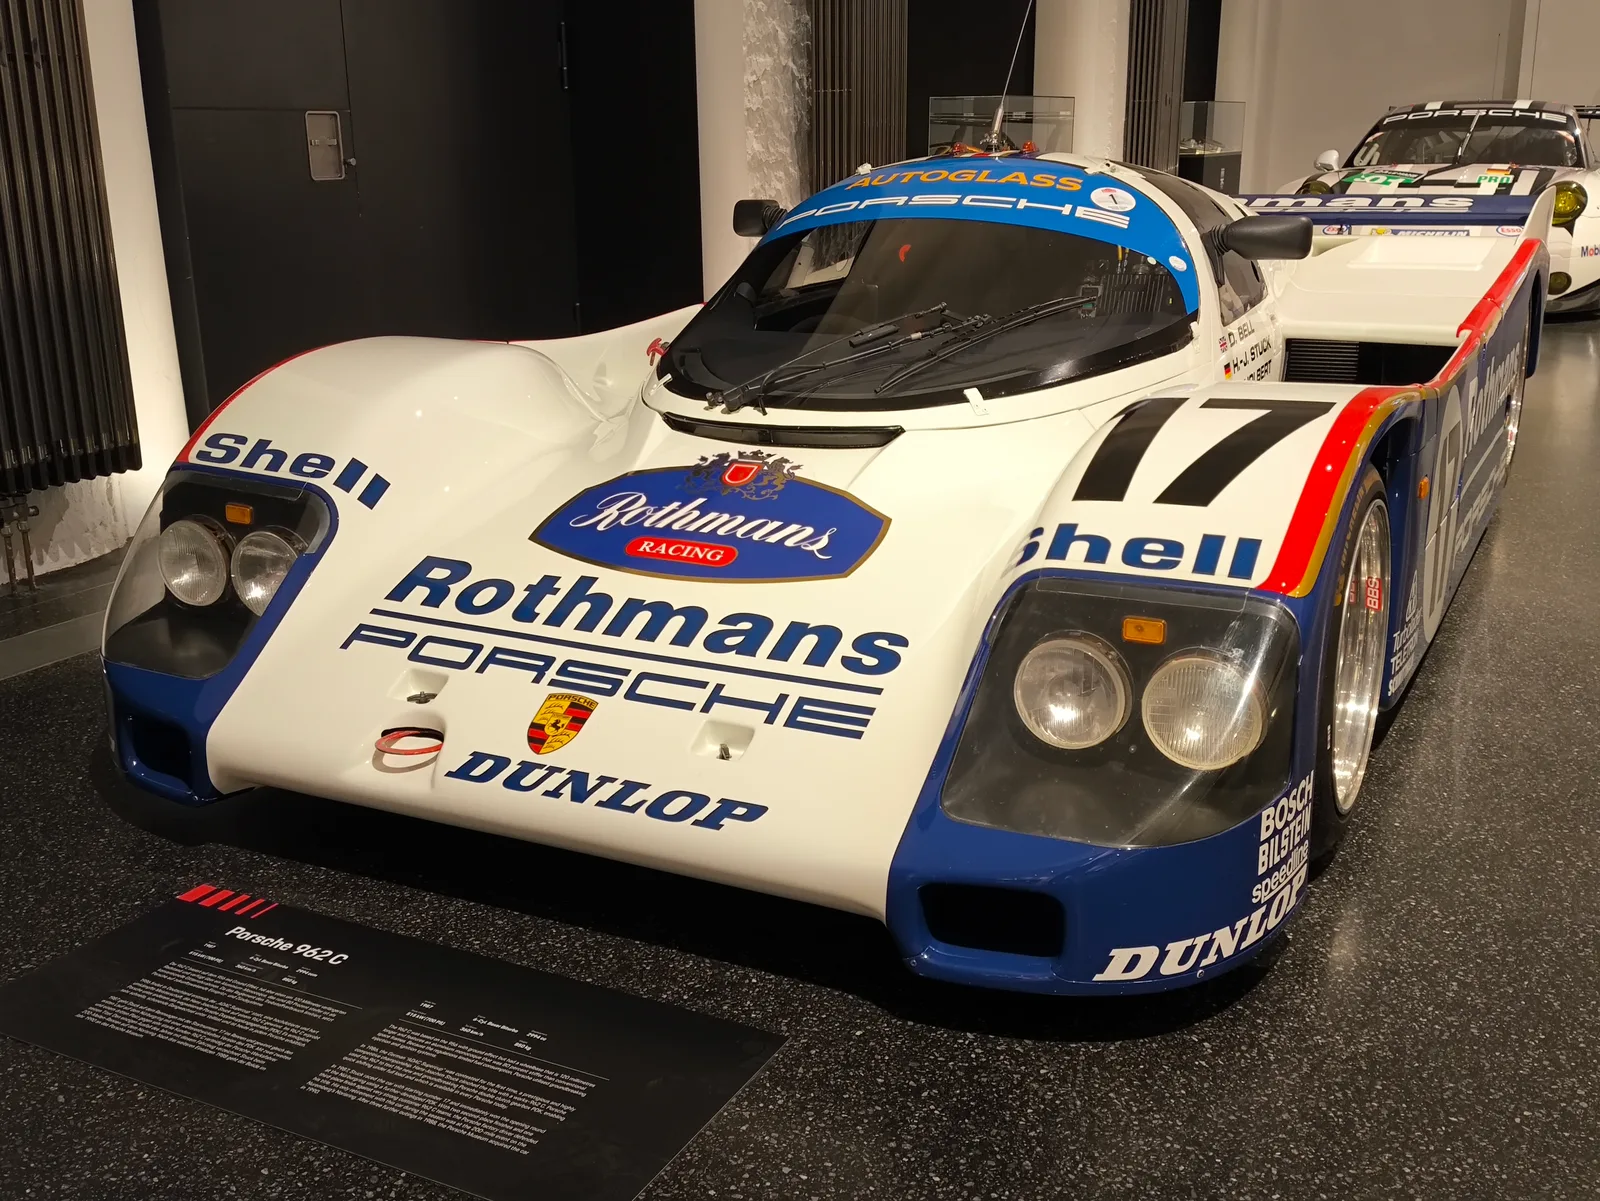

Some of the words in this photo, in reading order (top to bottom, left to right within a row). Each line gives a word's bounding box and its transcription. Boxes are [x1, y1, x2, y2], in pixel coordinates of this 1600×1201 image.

[1383, 109, 1567, 125] PORSCHE
[845, 169, 1084, 191] AUTOGLASS
[778, 194, 1131, 229] PORSCHE
[1237, 319, 1255, 342] BELL
[1249, 335, 1272, 362] STUCK
[195, 432, 391, 511] Shell
[1072, 397, 1338, 508] 17
[569, 491, 838, 560] Rothmans
[637, 540, 725, 562] RACING
[1008, 522, 1263, 580] Shell
[384, 555, 910, 676] Rothmans
[1366, 577, 1380, 610] BBS
[339, 622, 877, 740] PORSCHE
[548, 694, 596, 709] PORSCHE
[444, 750, 769, 831] DUNLOP
[1260, 770, 1314, 842] BOSCH
[1258, 802, 1311, 876] BILSTEIN
[1251, 839, 1309, 904] speedline
[225, 926, 294, 951] Porsche
[293, 943, 333, 962] 962
[328, 953, 349, 965] C
[1092, 870, 1307, 982] DUNLOP
